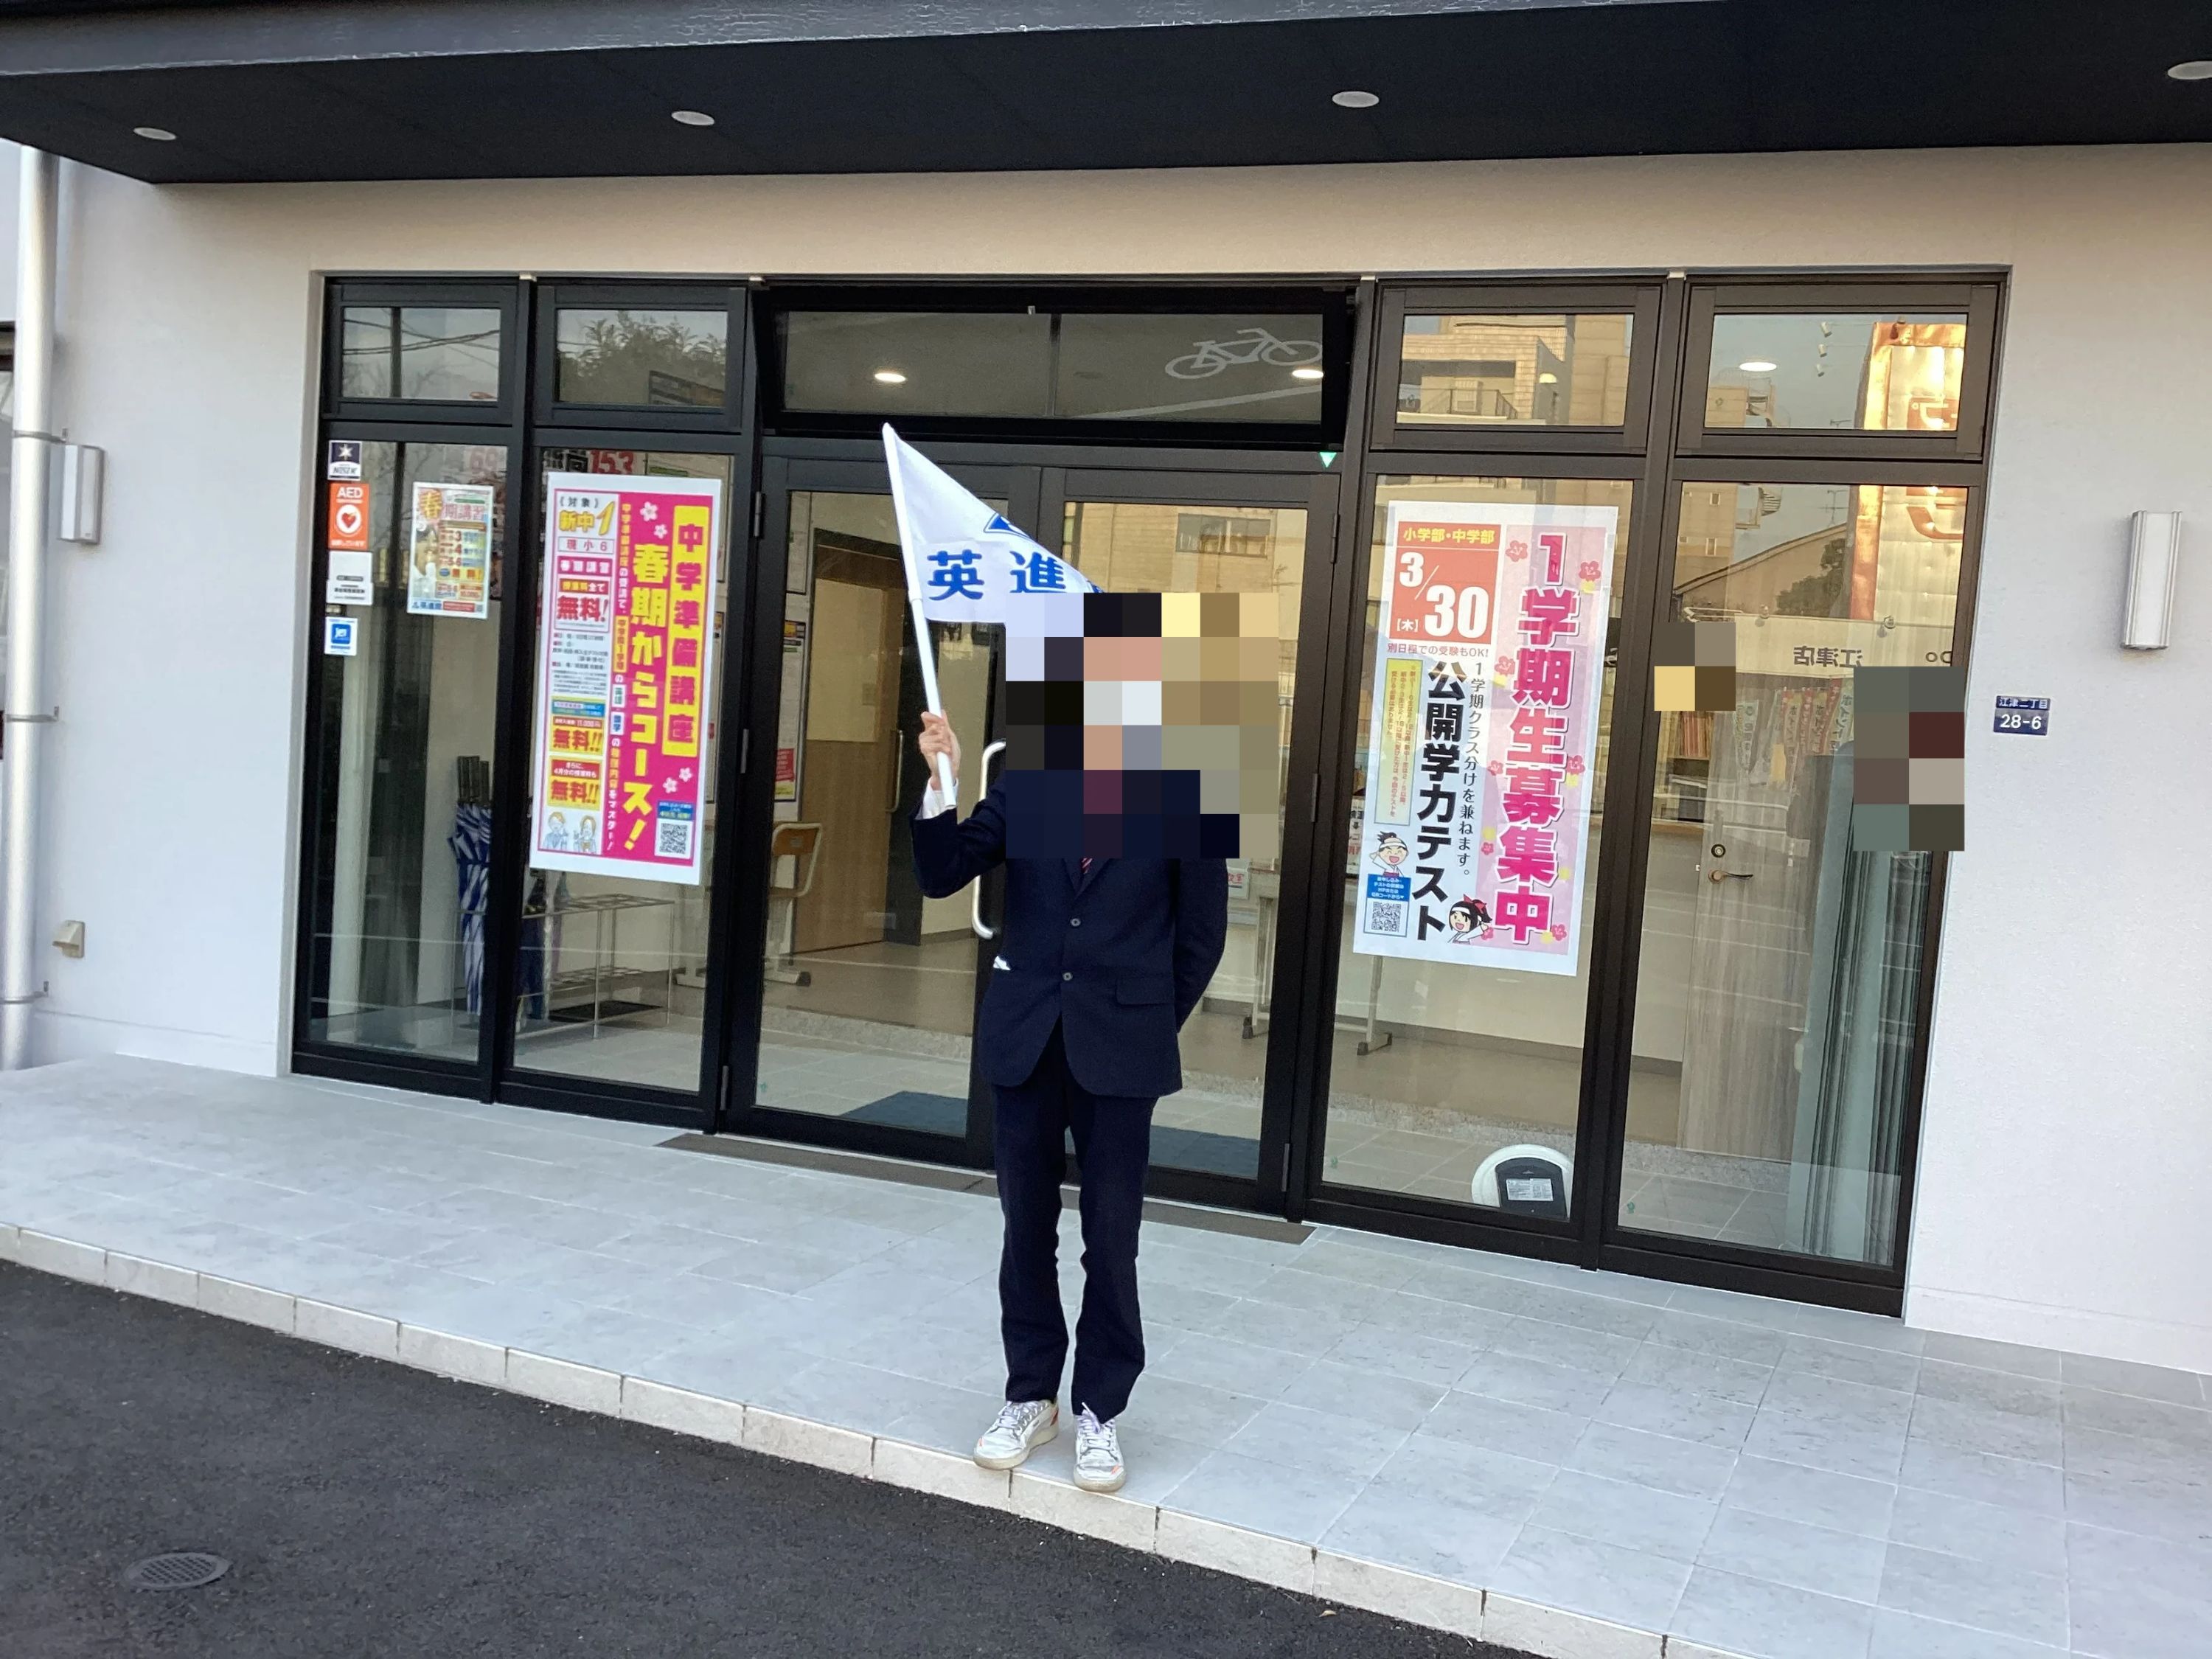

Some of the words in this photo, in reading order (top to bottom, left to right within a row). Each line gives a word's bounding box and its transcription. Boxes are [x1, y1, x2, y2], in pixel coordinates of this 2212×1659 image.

[337, 487, 364, 498] AED
[1403, 527, 1495, 544] 小学部・中学部
[927, 549, 1105, 600] 英進
[1998, 697, 2048, 709] 江津二丁目
[1492, 532, 1581, 945] 1学期生募集中
[2000, 714, 2042, 730] 28-6
[1456, 662, 1486, 876] 1学期クラス分けを兼ねます。
[1411, 661, 1468, 942] 公開学力テスト
